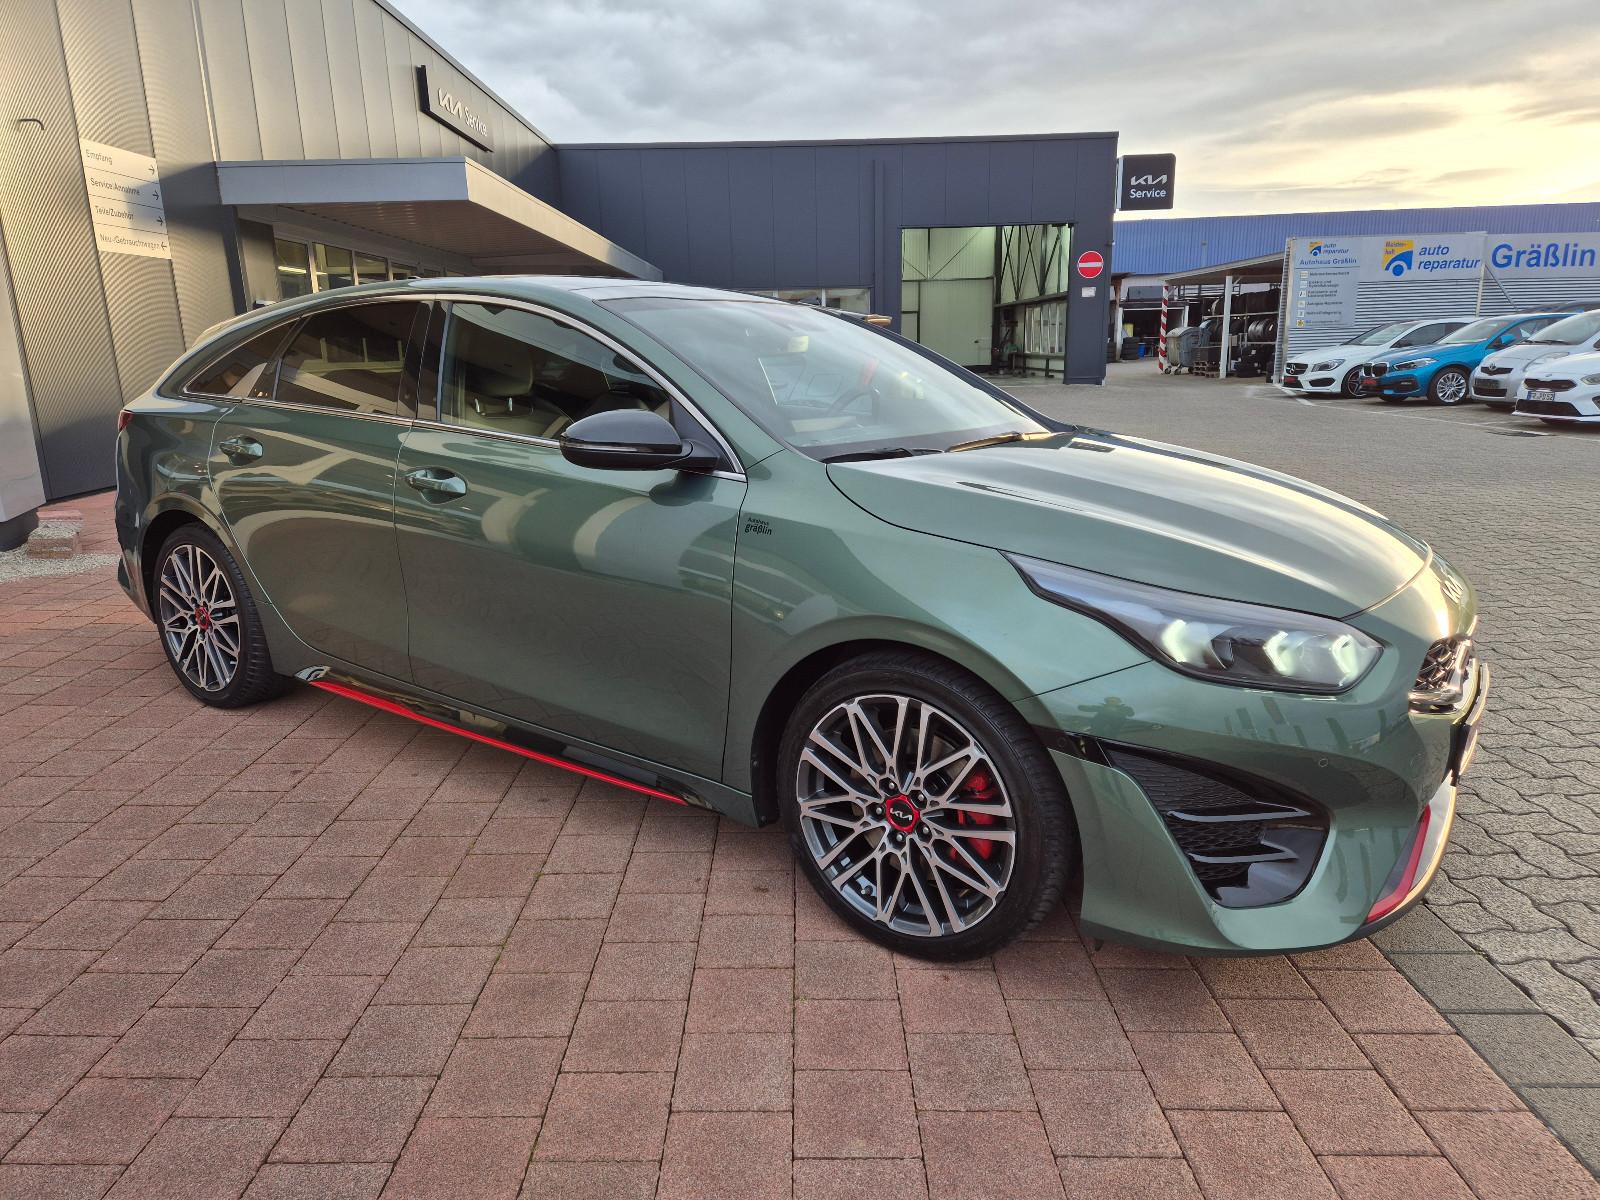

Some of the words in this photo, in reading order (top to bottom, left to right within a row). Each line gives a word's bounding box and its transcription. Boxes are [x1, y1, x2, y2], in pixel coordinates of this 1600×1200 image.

[464, 106, 488, 137] Service
[90, 177, 113, 190] Service
[1129, 188, 1167, 198] Service
[1418, 244, 1450, 256] auto
[1491, 242, 1597, 269] Gräßlin
[1418, 258, 1481, 273] reparatur
